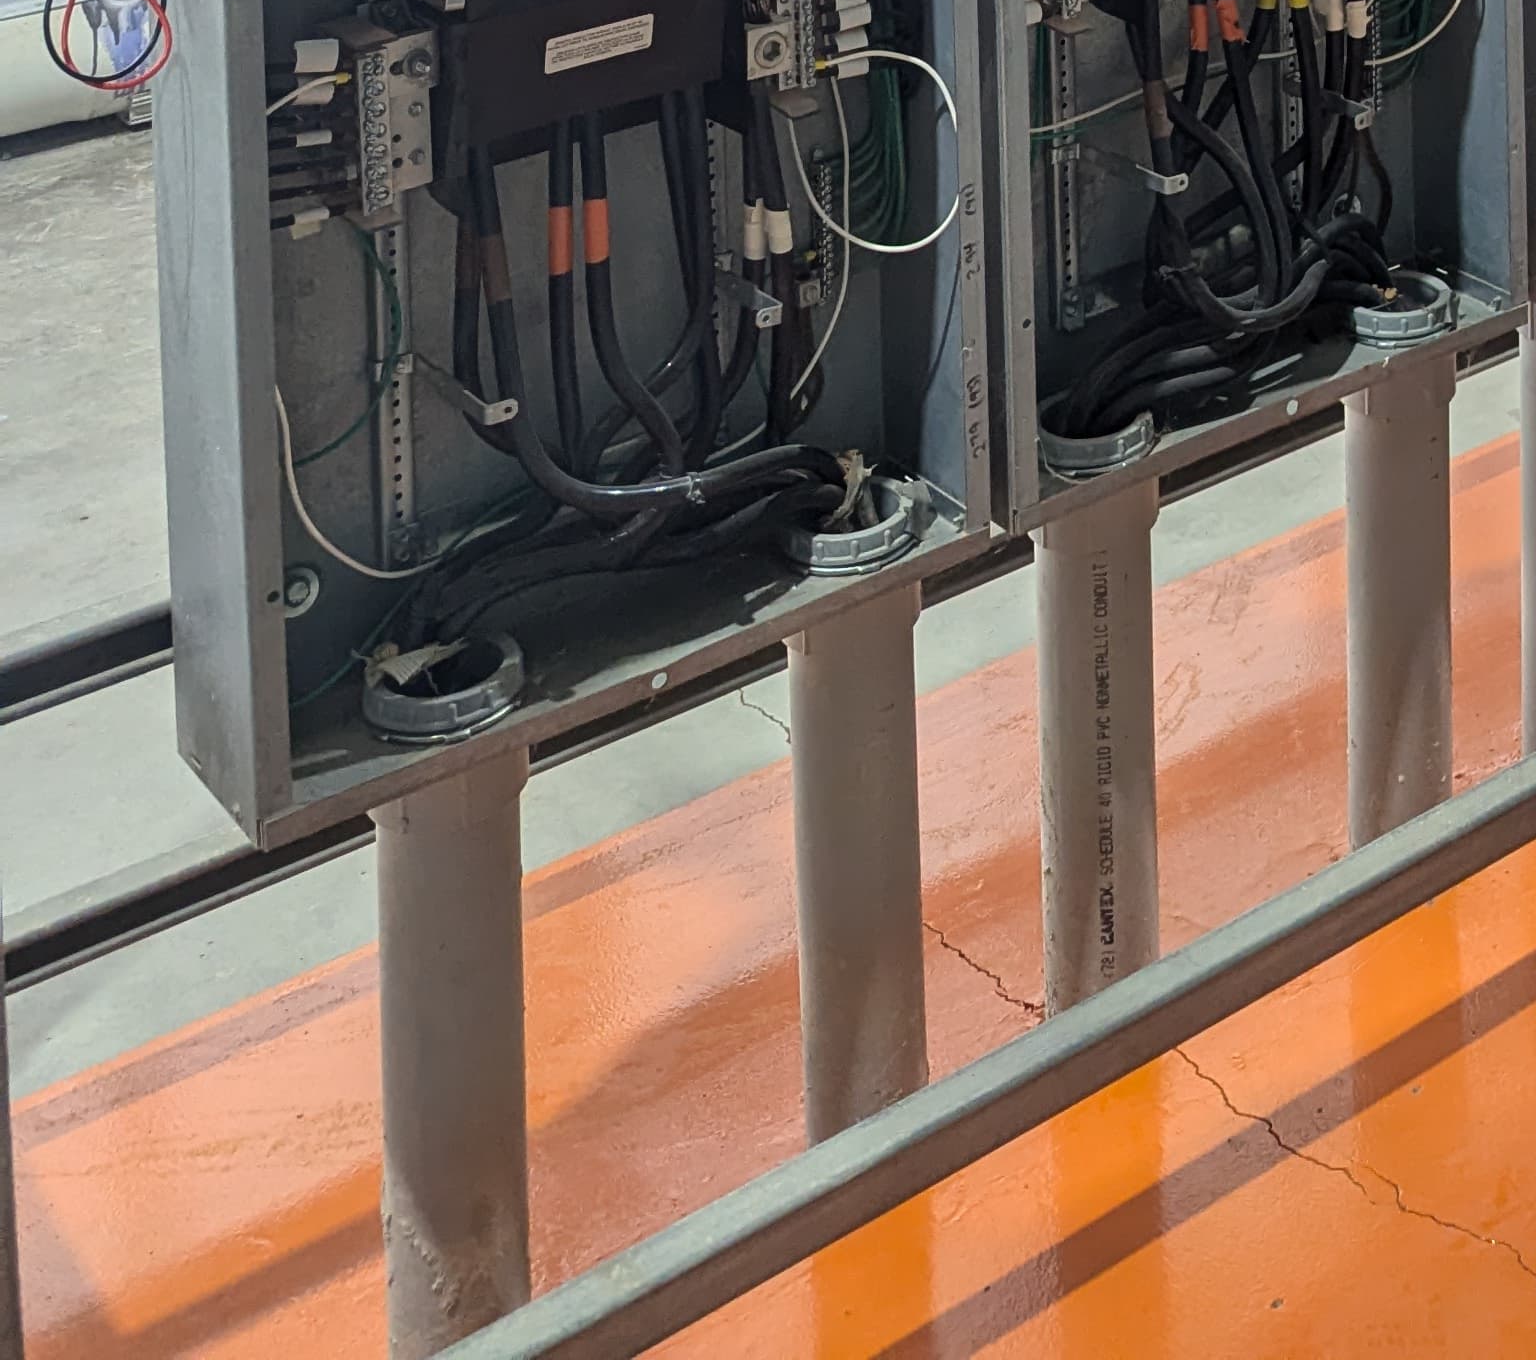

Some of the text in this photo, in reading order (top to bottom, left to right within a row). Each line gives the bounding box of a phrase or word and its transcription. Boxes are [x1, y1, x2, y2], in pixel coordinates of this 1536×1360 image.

[1092, 563, 1109, 618] CONDUIT
[1096, 626, 1110, 709] NONMETALLIC
[1097, 714, 1111, 741] PVC
[1098, 744, 1112, 785] RIGID
[1101, 791, 1112, 808] 40
[1101, 814, 1114, 875] SCHEDULE
[1101, 882, 1115, 945] CANTEX
